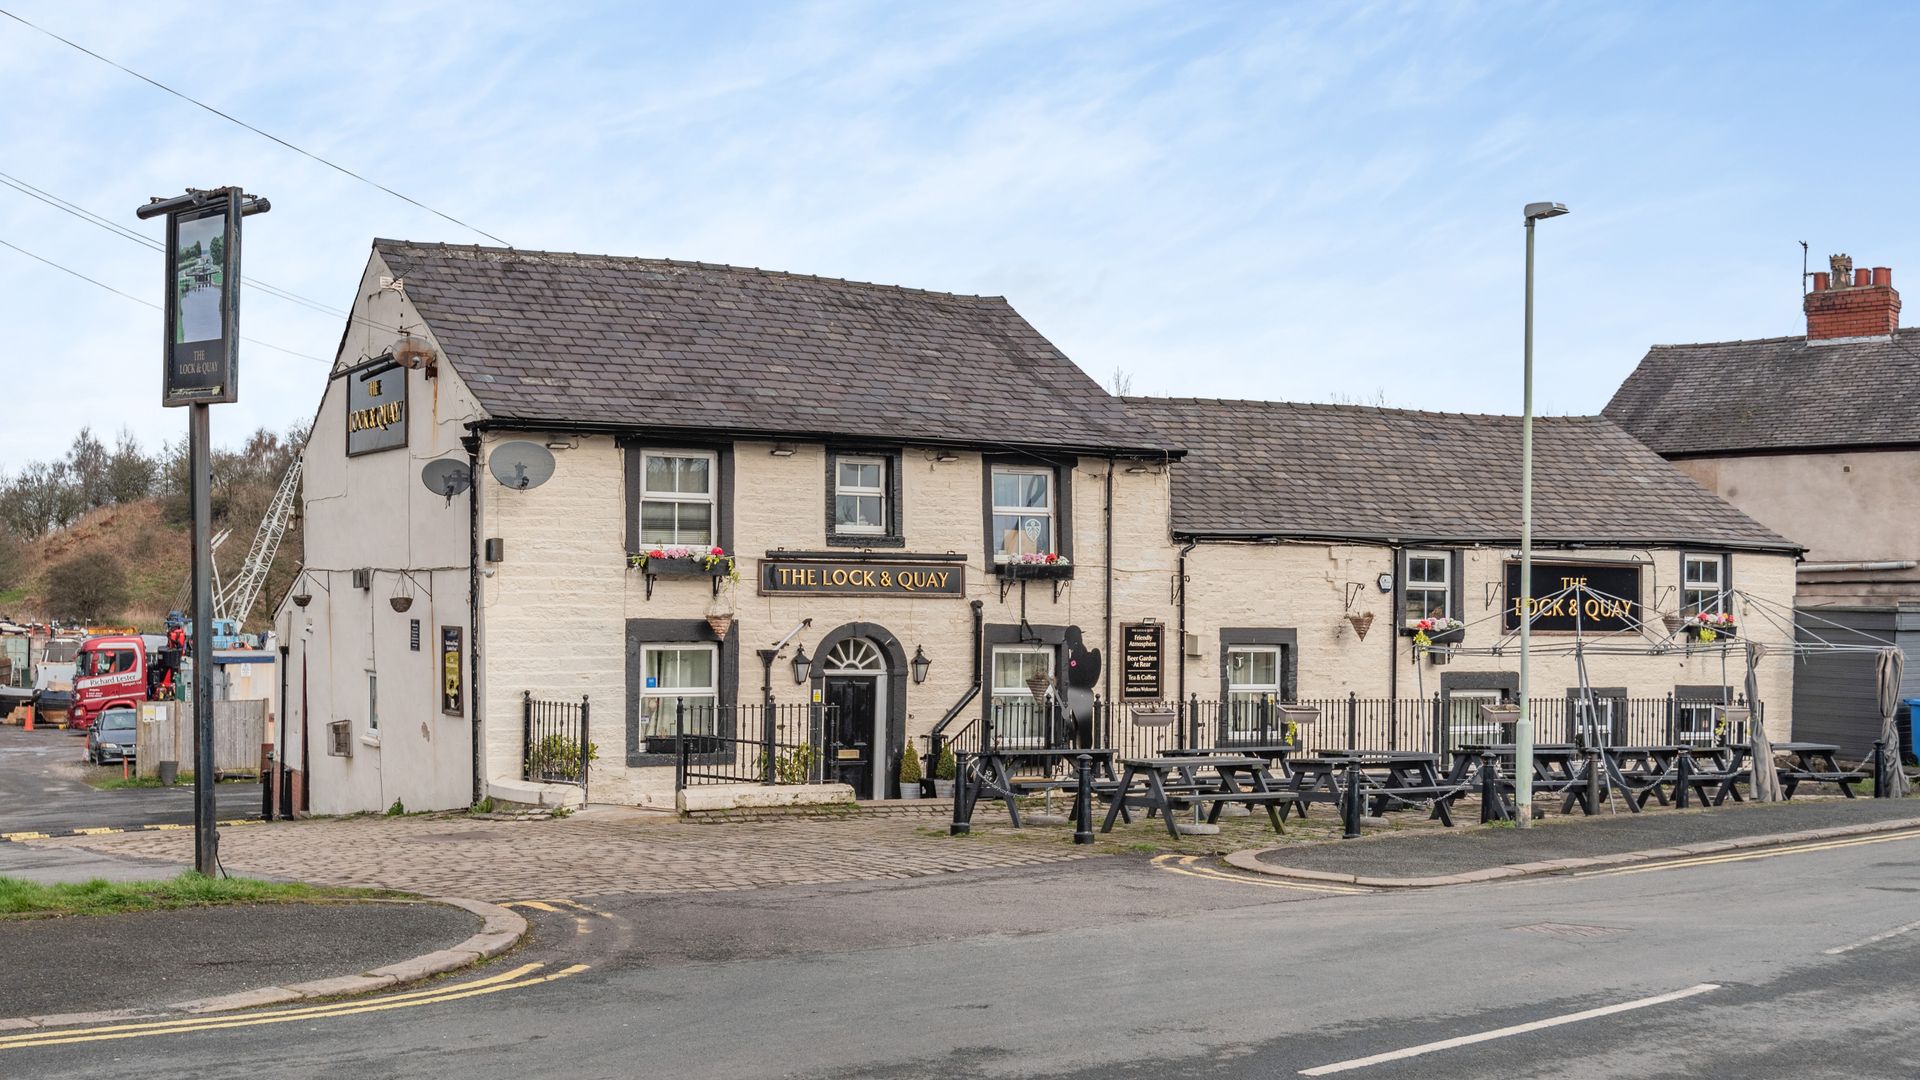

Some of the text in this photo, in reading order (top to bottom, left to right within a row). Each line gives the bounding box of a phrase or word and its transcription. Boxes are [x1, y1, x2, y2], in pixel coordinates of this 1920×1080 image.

[194, 350, 205, 361] THE
[180, 363, 195, 375] LOCK
[202, 361, 218, 375] QUAY
[777, 568, 949, 591] THE LOCK & QUAY
[1561, 577, 1588, 591] THE
[1568, 599, 1579, 616] &
[1585, 600, 1633, 621] QUAY
[89, 674, 136, 687] Richard Lester
